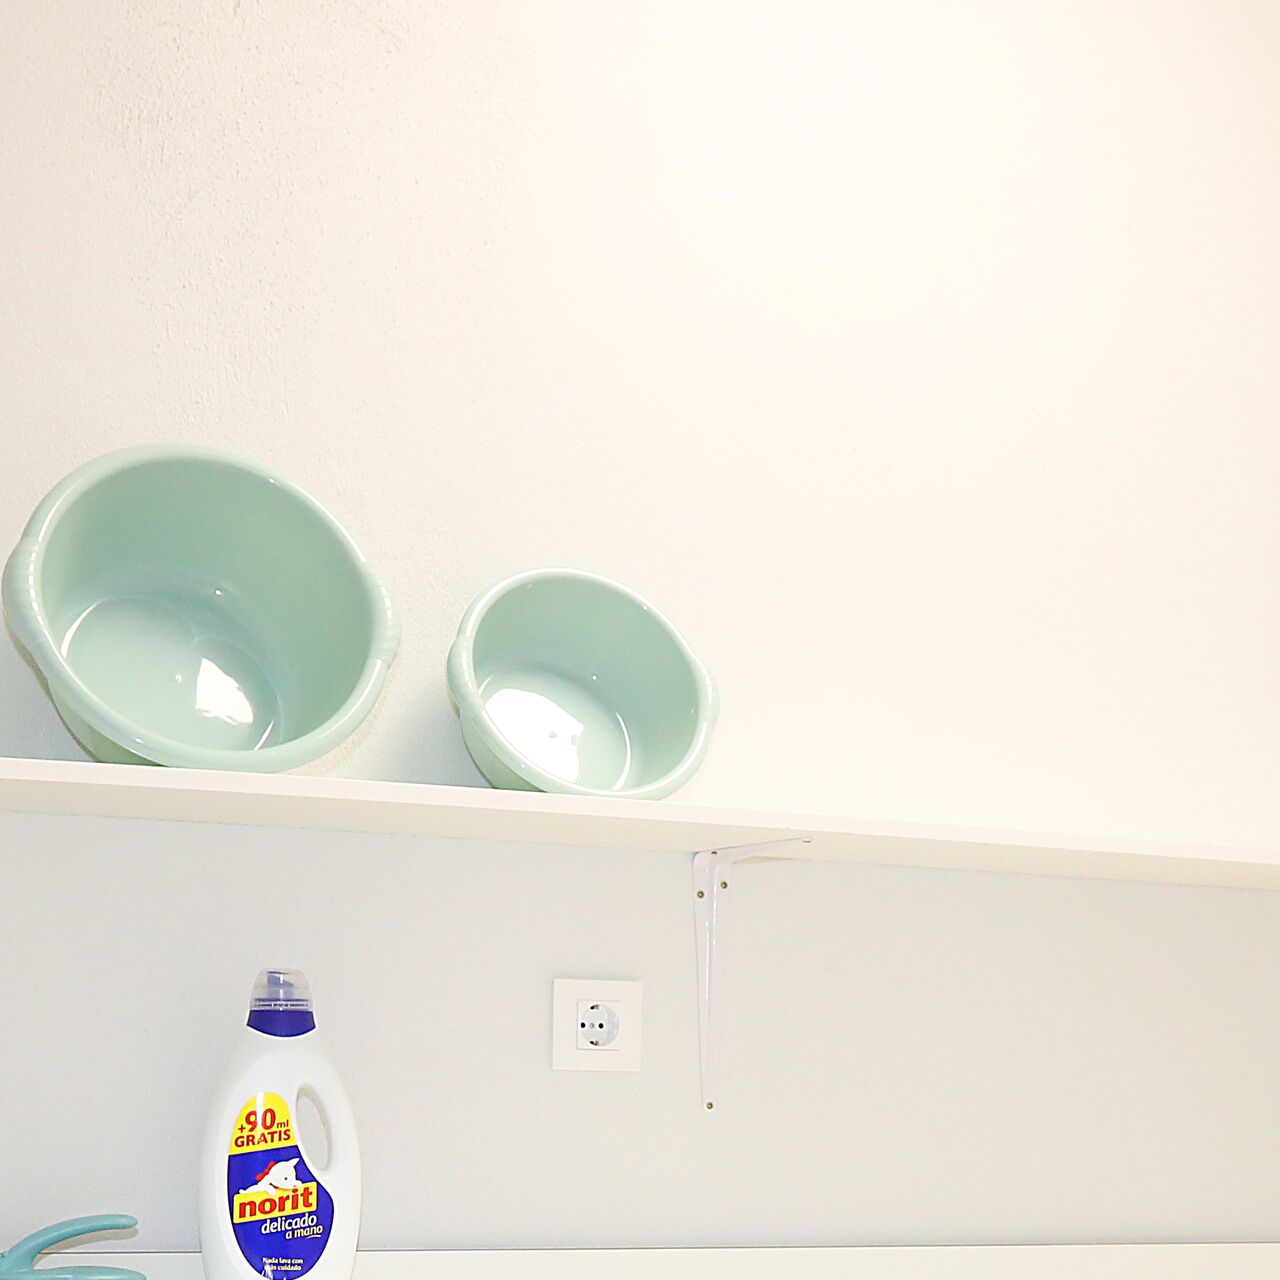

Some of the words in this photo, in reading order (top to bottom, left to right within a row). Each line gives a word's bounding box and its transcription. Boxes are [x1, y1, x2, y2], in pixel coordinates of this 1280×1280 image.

[234, 1129, 291, 1148] GRATIS
[238, 1187, 313, 1218] norit
[261, 1213, 317, 1234] delicado
[285, 1231, 293, 1240] a
[294, 1225, 324, 1238] mano
